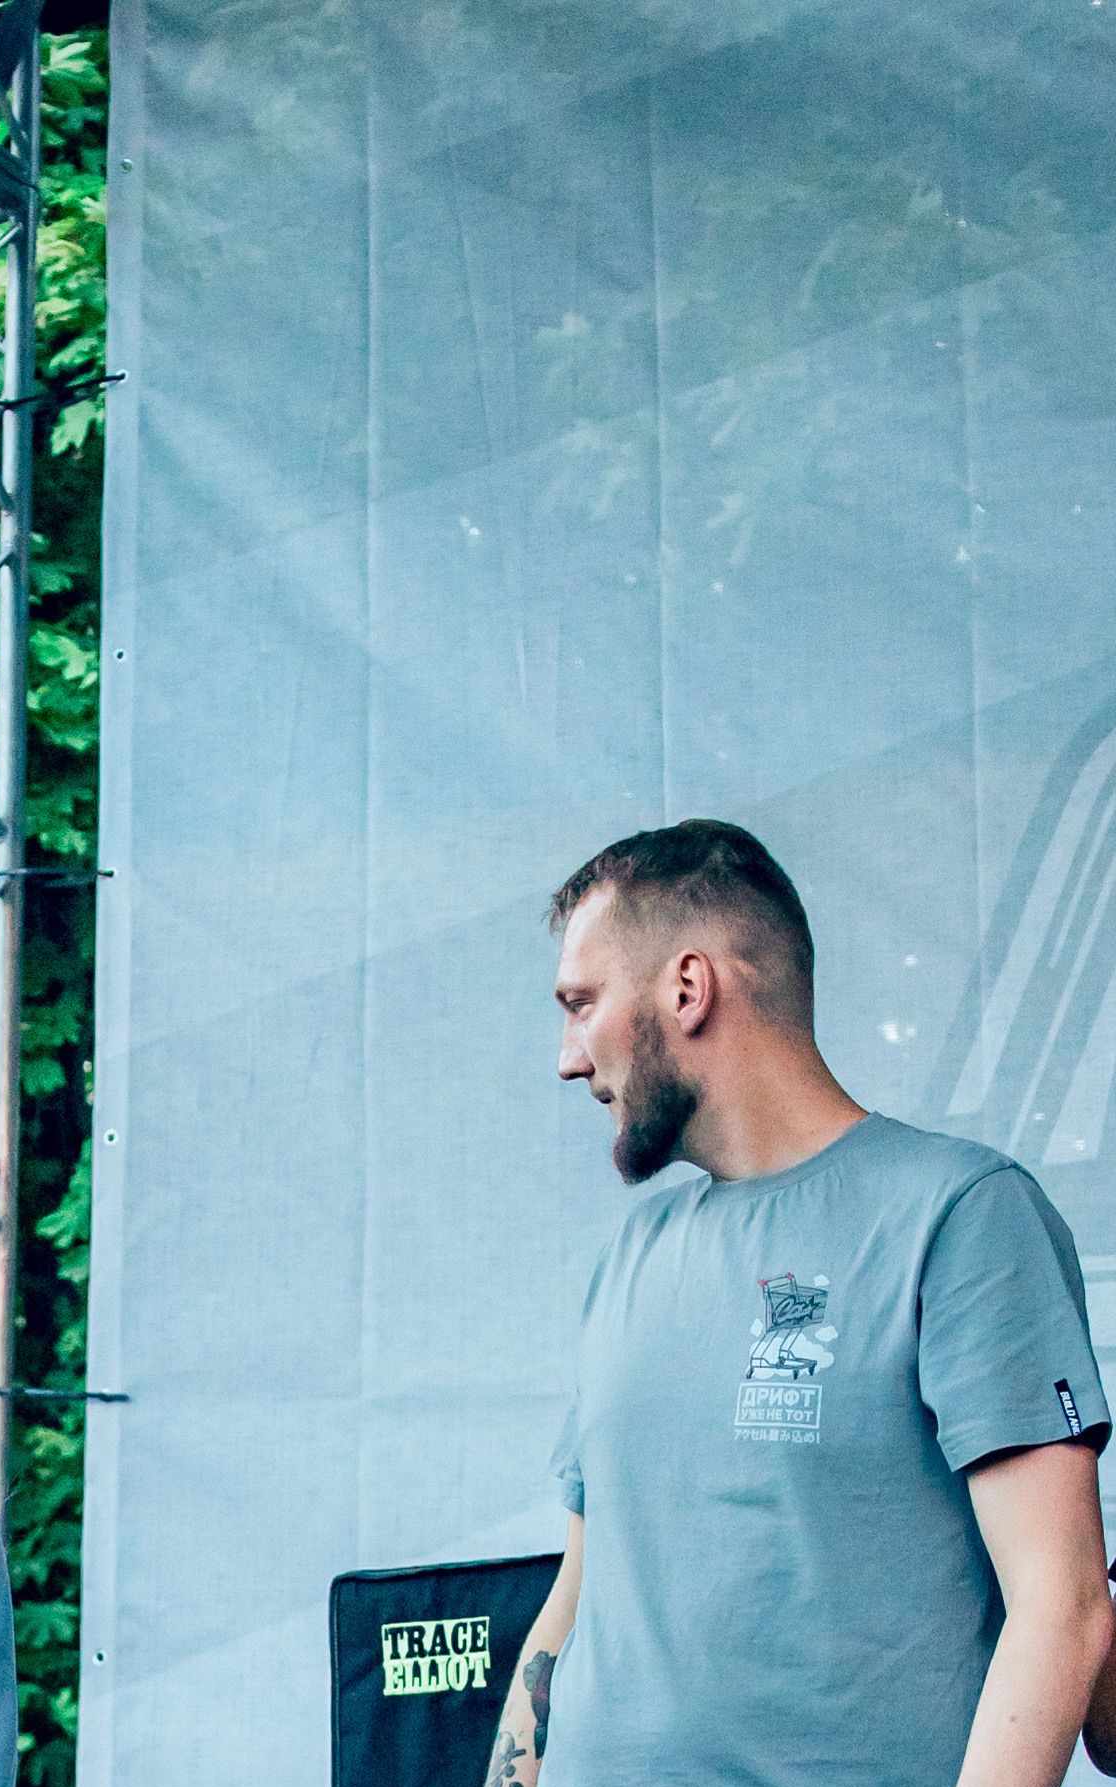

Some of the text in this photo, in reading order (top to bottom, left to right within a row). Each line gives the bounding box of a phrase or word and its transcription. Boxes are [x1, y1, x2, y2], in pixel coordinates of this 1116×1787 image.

[742, 1387, 816, 1407] ДРИФТ
[741, 1408, 814, 1423] УЖЕ НЕ ТОТ
[385, 1619, 488, 1660] TRACE
[383, 1652, 491, 1696] ELLIOT
